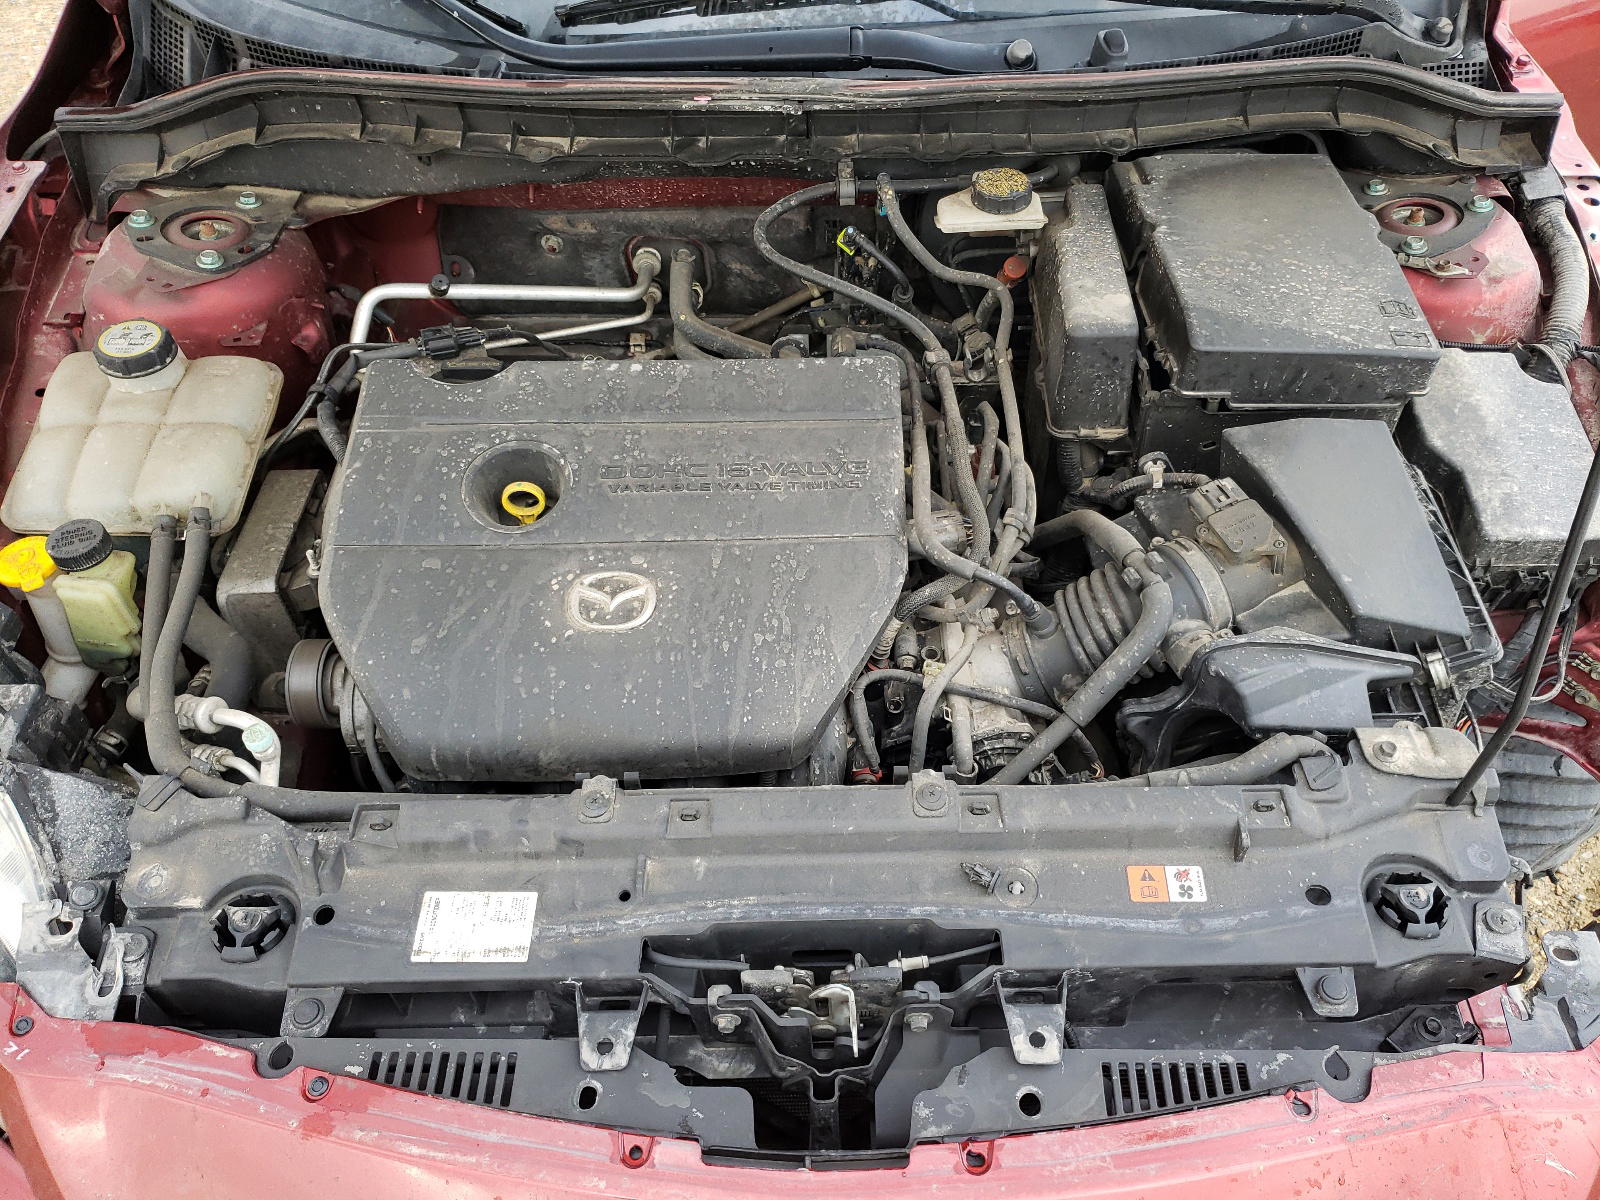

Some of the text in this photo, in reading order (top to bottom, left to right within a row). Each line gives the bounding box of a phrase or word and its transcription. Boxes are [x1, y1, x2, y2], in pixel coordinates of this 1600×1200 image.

[599, 459, 871, 480] DOHC 16-VALVE
[608, 480, 863, 494] VARIABLE VALVE TIMING
[54, 529, 93, 544] STEERING
[60, 526, 87, 536] POWER
